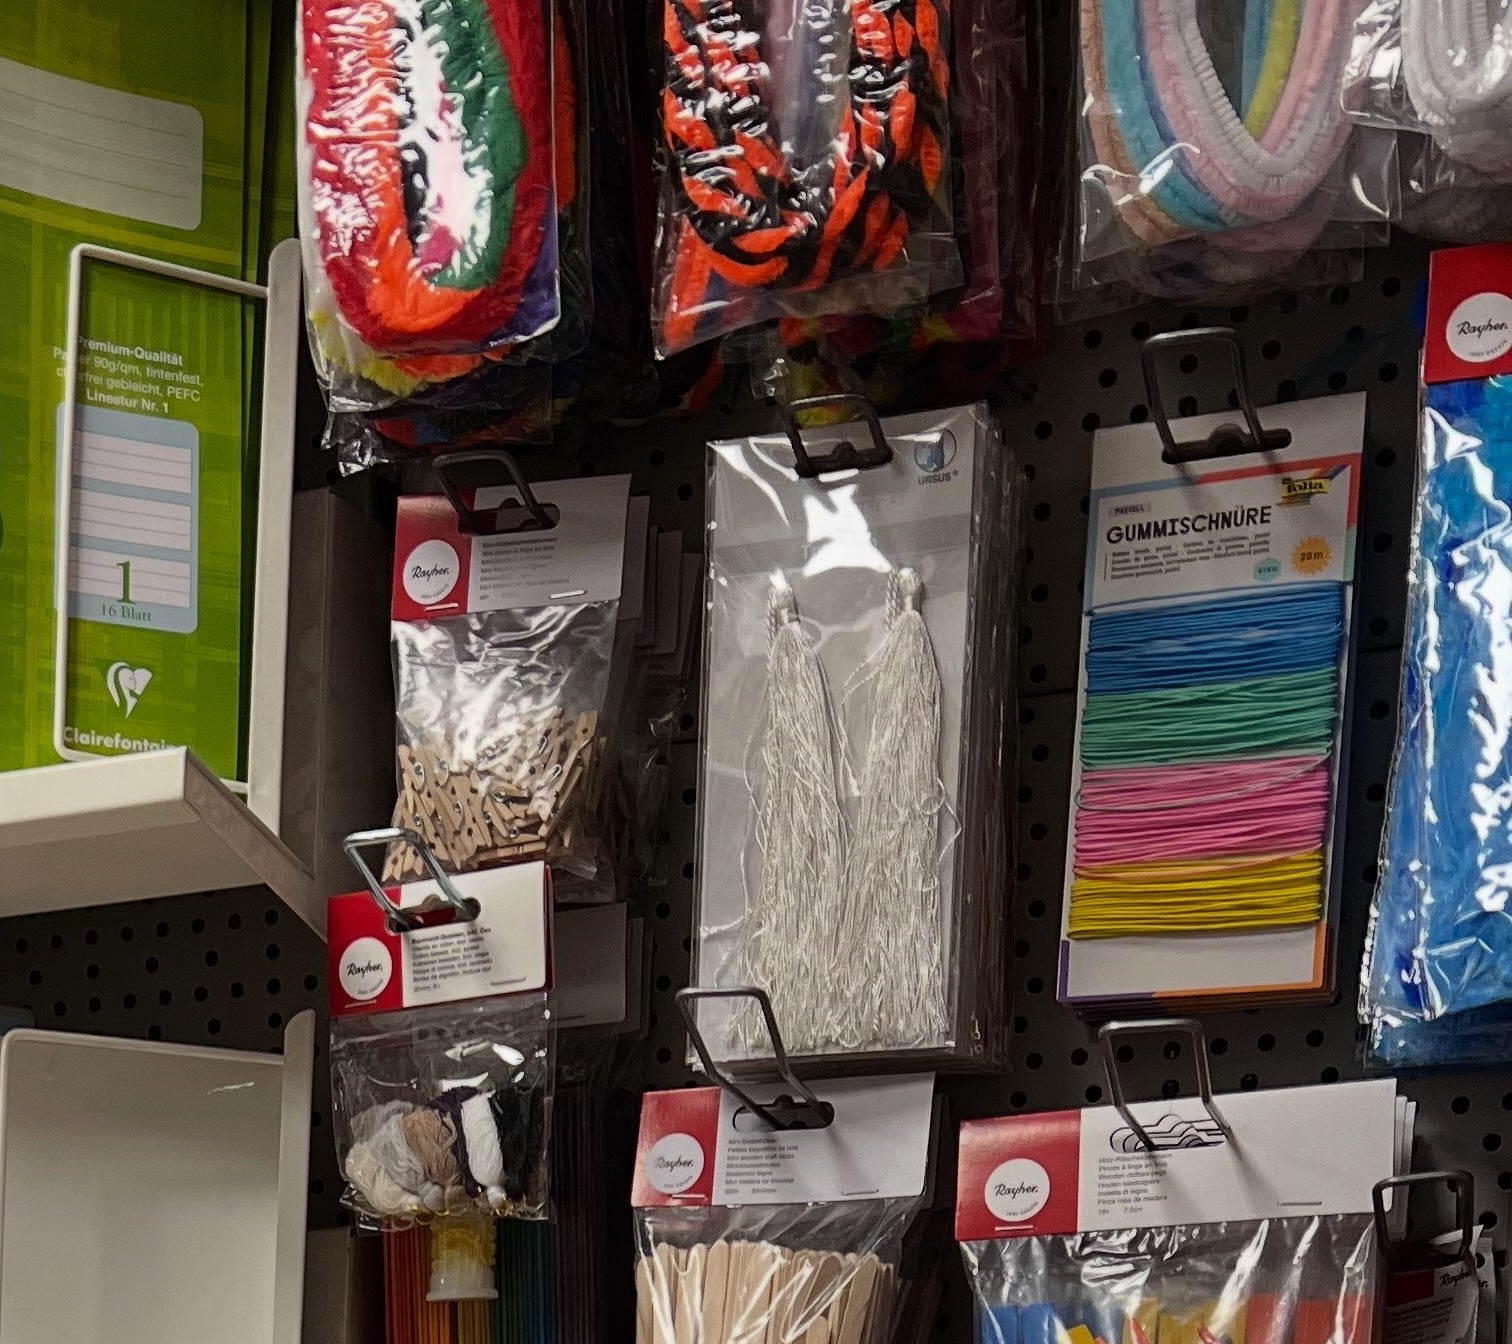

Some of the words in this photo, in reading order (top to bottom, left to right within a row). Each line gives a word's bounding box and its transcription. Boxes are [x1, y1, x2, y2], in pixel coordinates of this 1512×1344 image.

[93, 356, 142, 377] 90g/qm,
[145, 366, 203, 387] tintenfest,
[86, 389, 138, 409] Lineatur
[142, 399, 159, 412] Nr.
[106, 376, 163, 397] gebleicht,
[167, 387, 201, 402] PEFC
[1106, 505, 1272, 545] GUMMISCHNÜRE
[117, 560, 136, 605] 1
[100, 604, 117, 617] 16
[121, 606, 153, 622] Blatt
